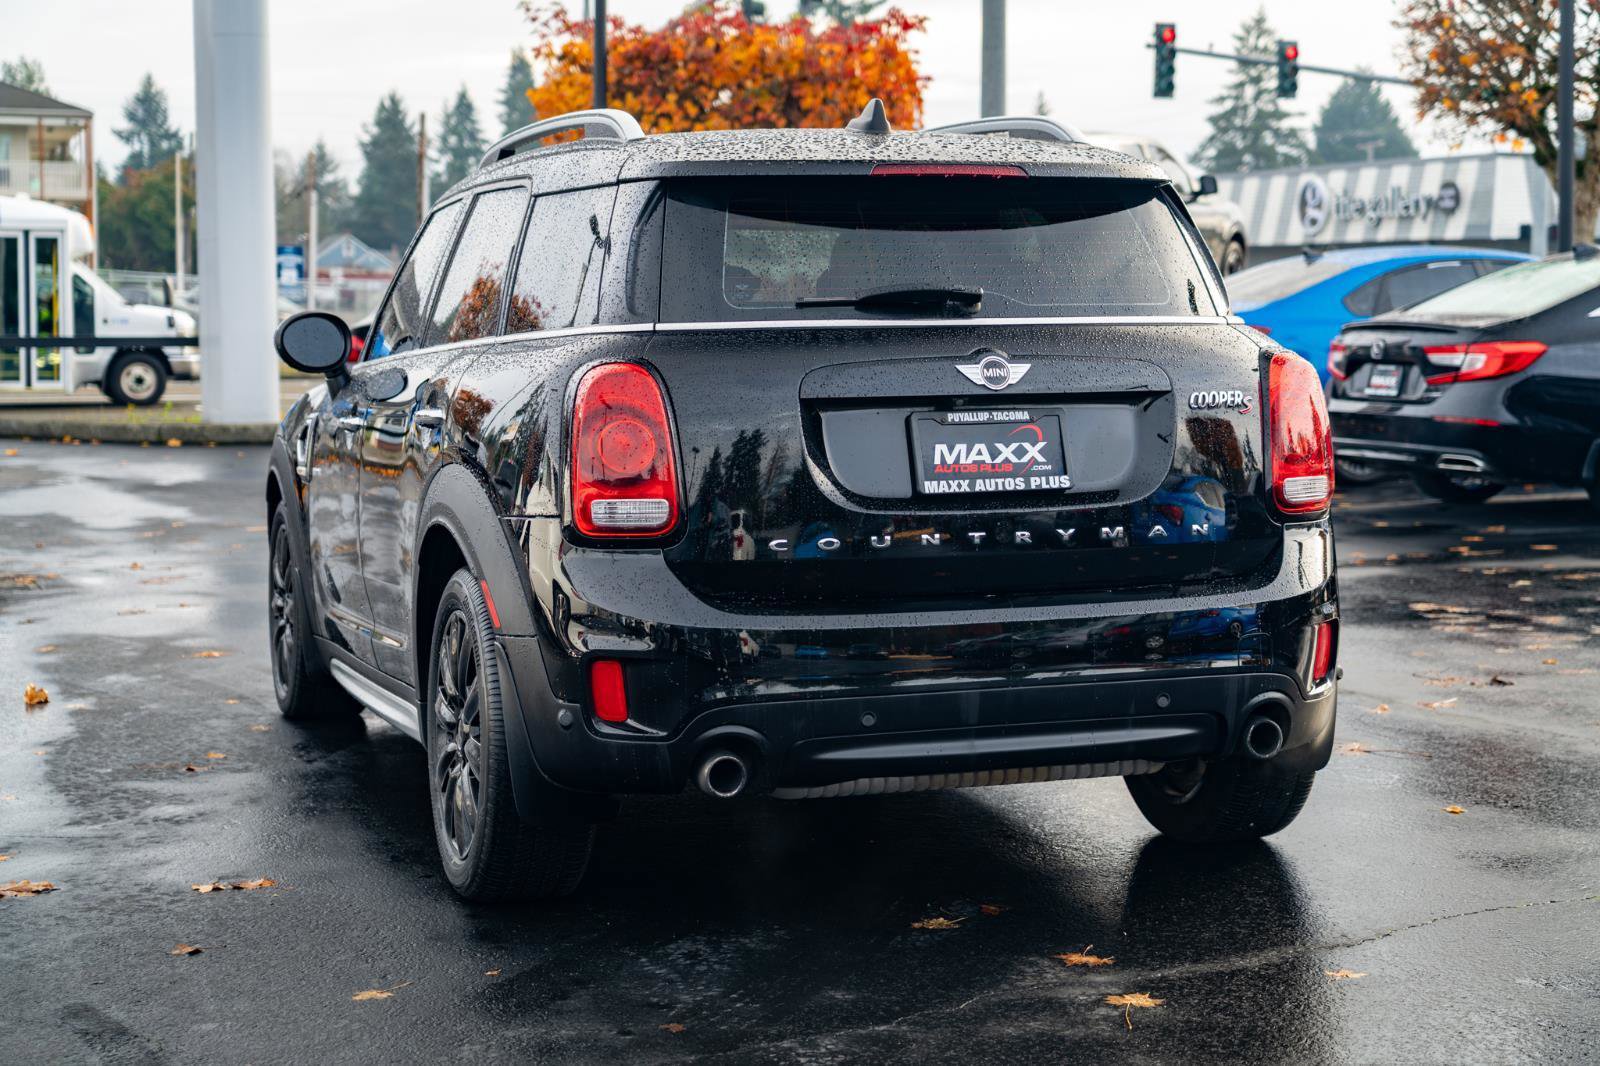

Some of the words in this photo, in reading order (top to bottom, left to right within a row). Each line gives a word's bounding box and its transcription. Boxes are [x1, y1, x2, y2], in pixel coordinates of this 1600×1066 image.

[1367, 185, 1434, 226] gallery
[983, 368, 1008, 377] MINI
[1190, 390, 1243, 408] COOPER
[934, 442, 1047, 464] MAXX
[934, 463, 978, 473] AUTOS
[980, 463, 1013, 472] PLUS
[924, 479, 970, 494] MAXX
[975, 478, 1025, 492] AUTOS
[1031, 475, 1070, 489] PLUS
[768, 523, 1209, 550] COUNTRYMAN
